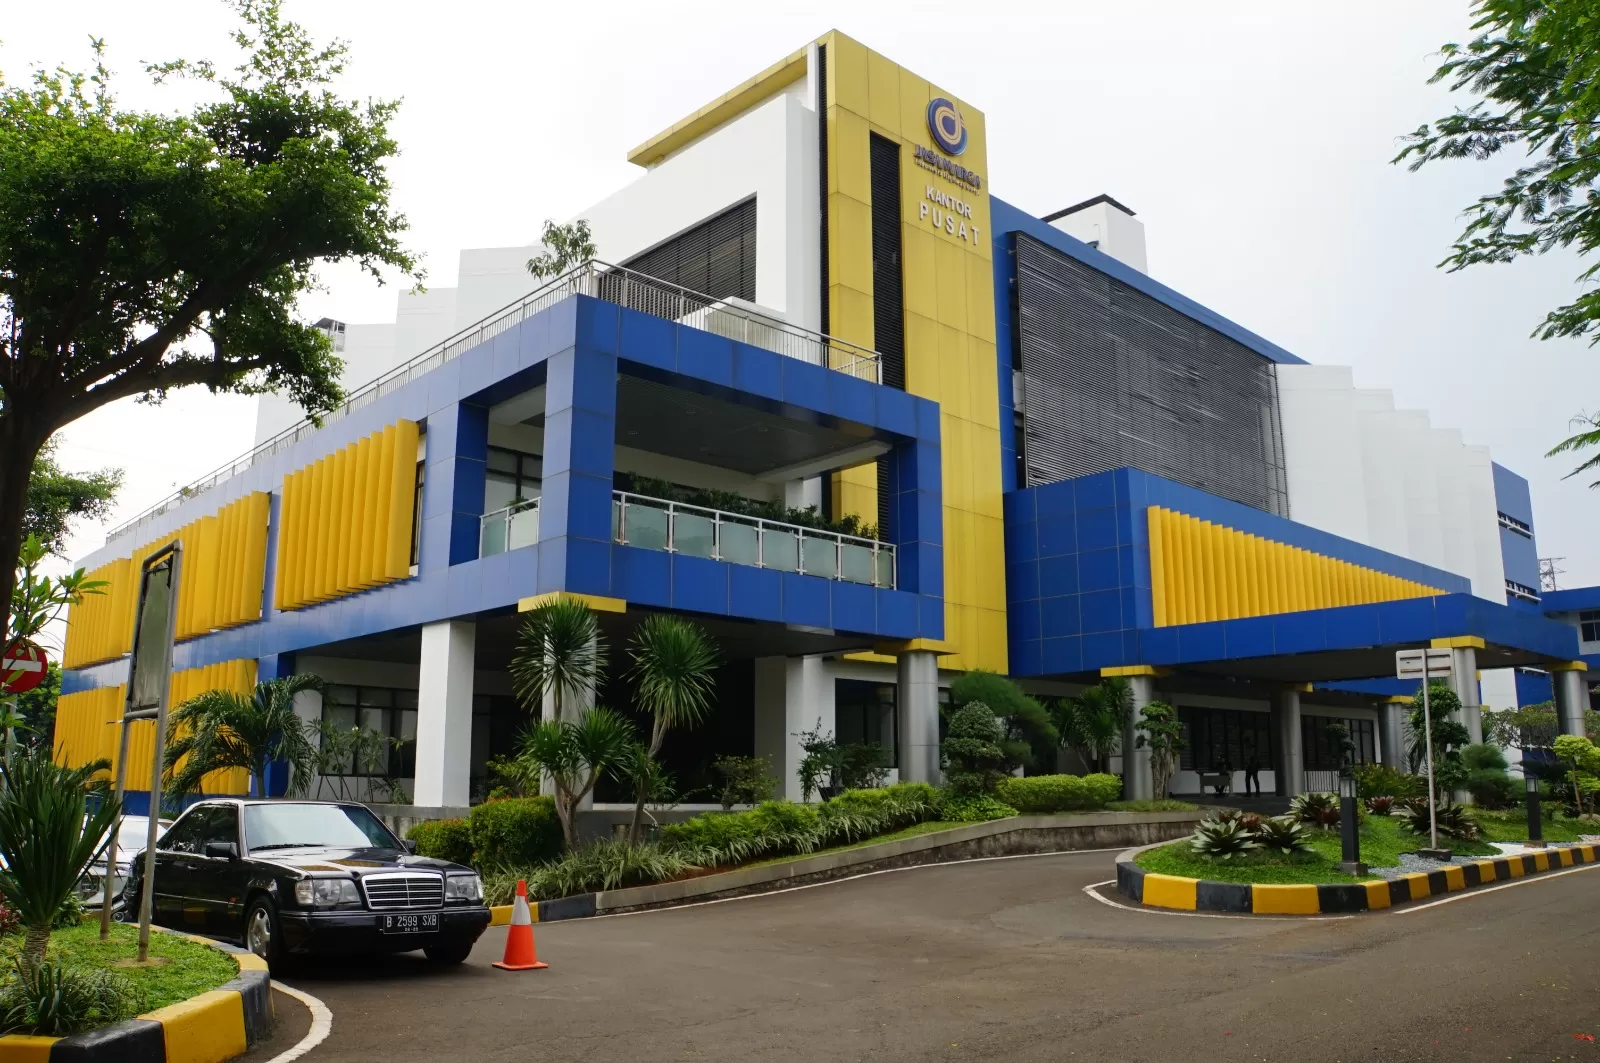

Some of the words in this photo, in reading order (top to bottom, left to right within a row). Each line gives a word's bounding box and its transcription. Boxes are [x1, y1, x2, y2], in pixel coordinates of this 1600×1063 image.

[926, 184, 972, 219] KANTOR
[919, 201, 980, 245] PUSAT
[387, 917, 393, 928] B
[397, 916, 418, 927] 2599
[422, 915, 437, 926] SXB
